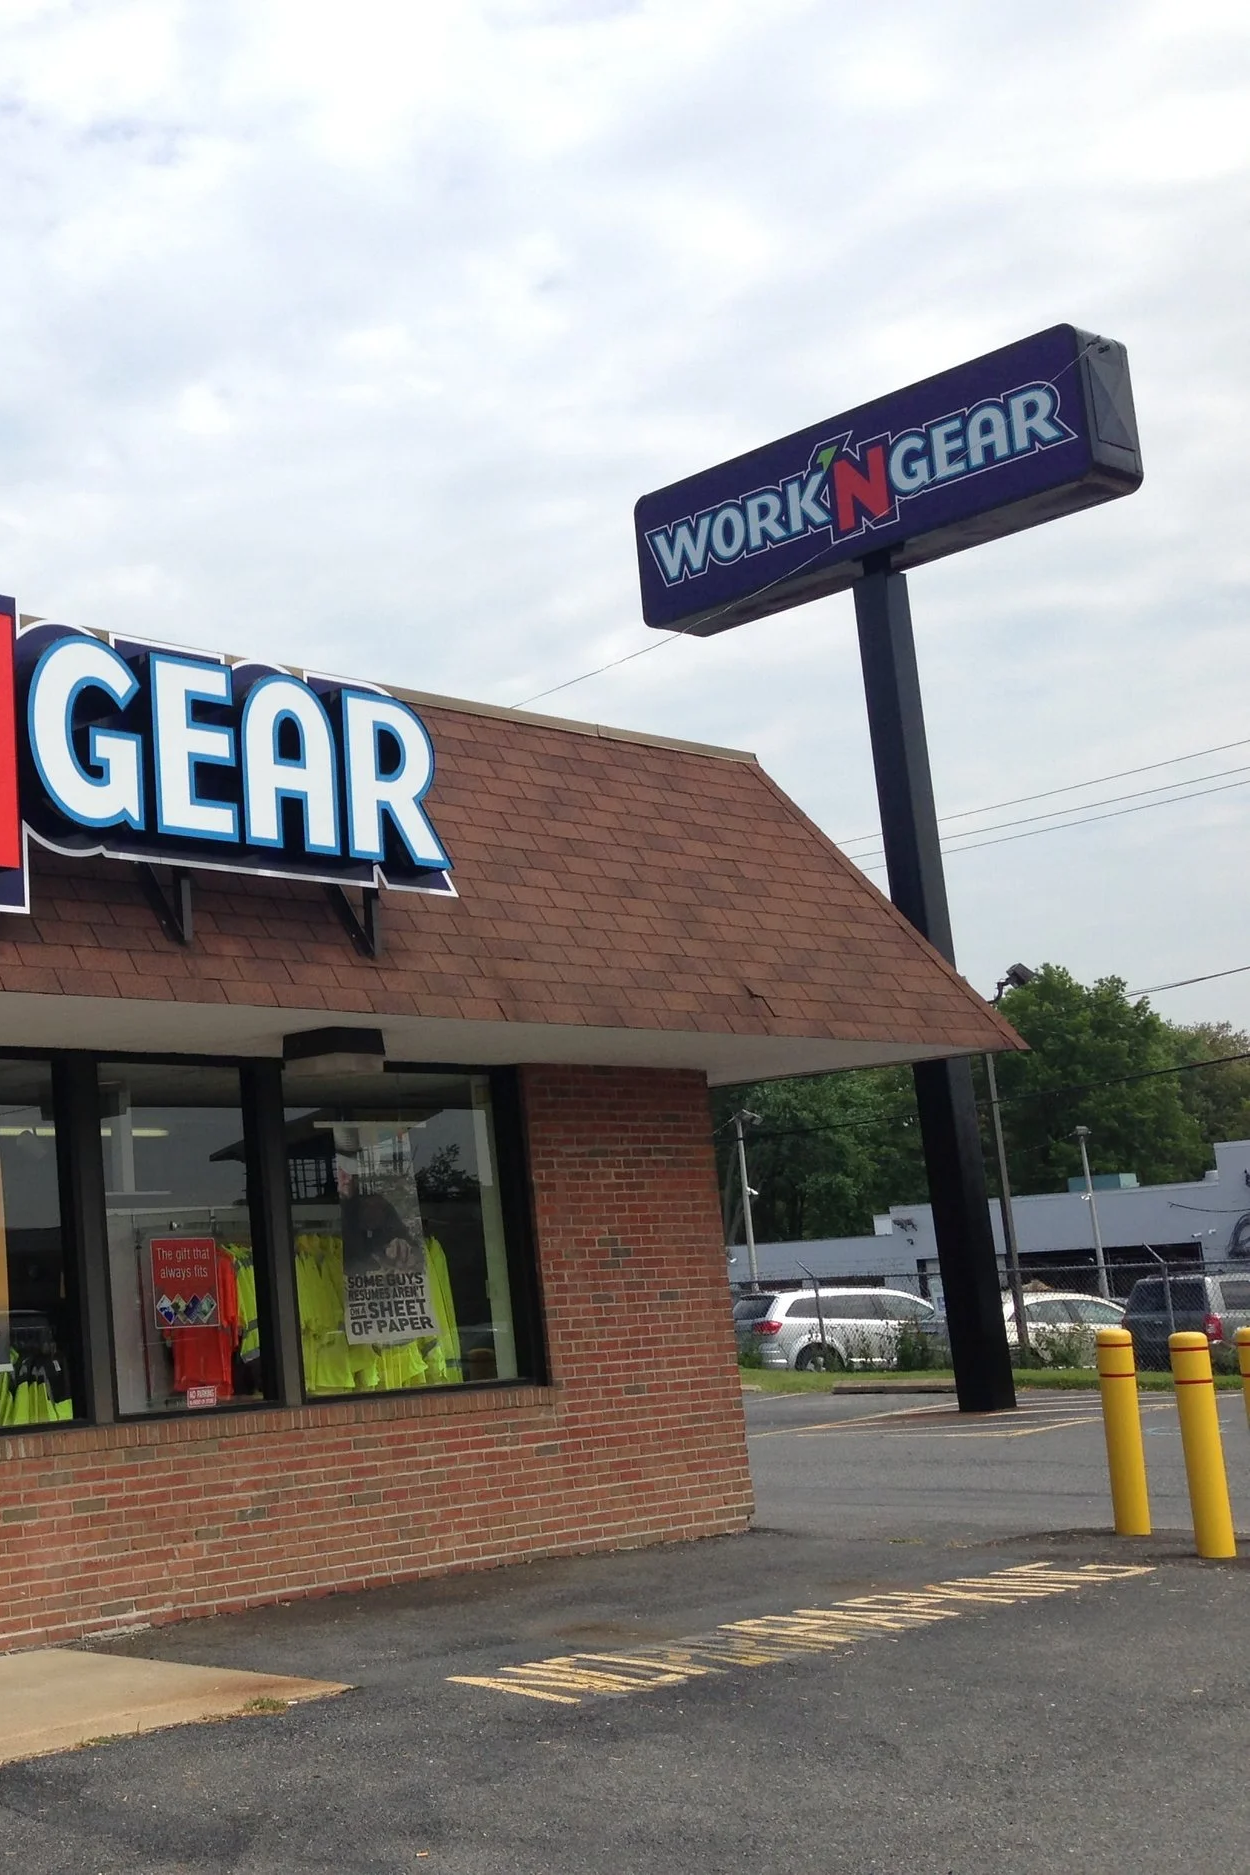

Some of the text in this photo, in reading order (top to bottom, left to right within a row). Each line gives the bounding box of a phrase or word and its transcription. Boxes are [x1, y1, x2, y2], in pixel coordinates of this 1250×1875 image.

[156, 1247, 211, 1263] The gift that
[159, 1264, 208, 1281] always fits
[347, 1272, 424, 1289] SOME GUYS
[348, 1285, 425, 1302] RESUMES AREN'T
[367, 1298, 426, 1320] SHEET
[351, 1316, 435, 1336] OF PAPER
